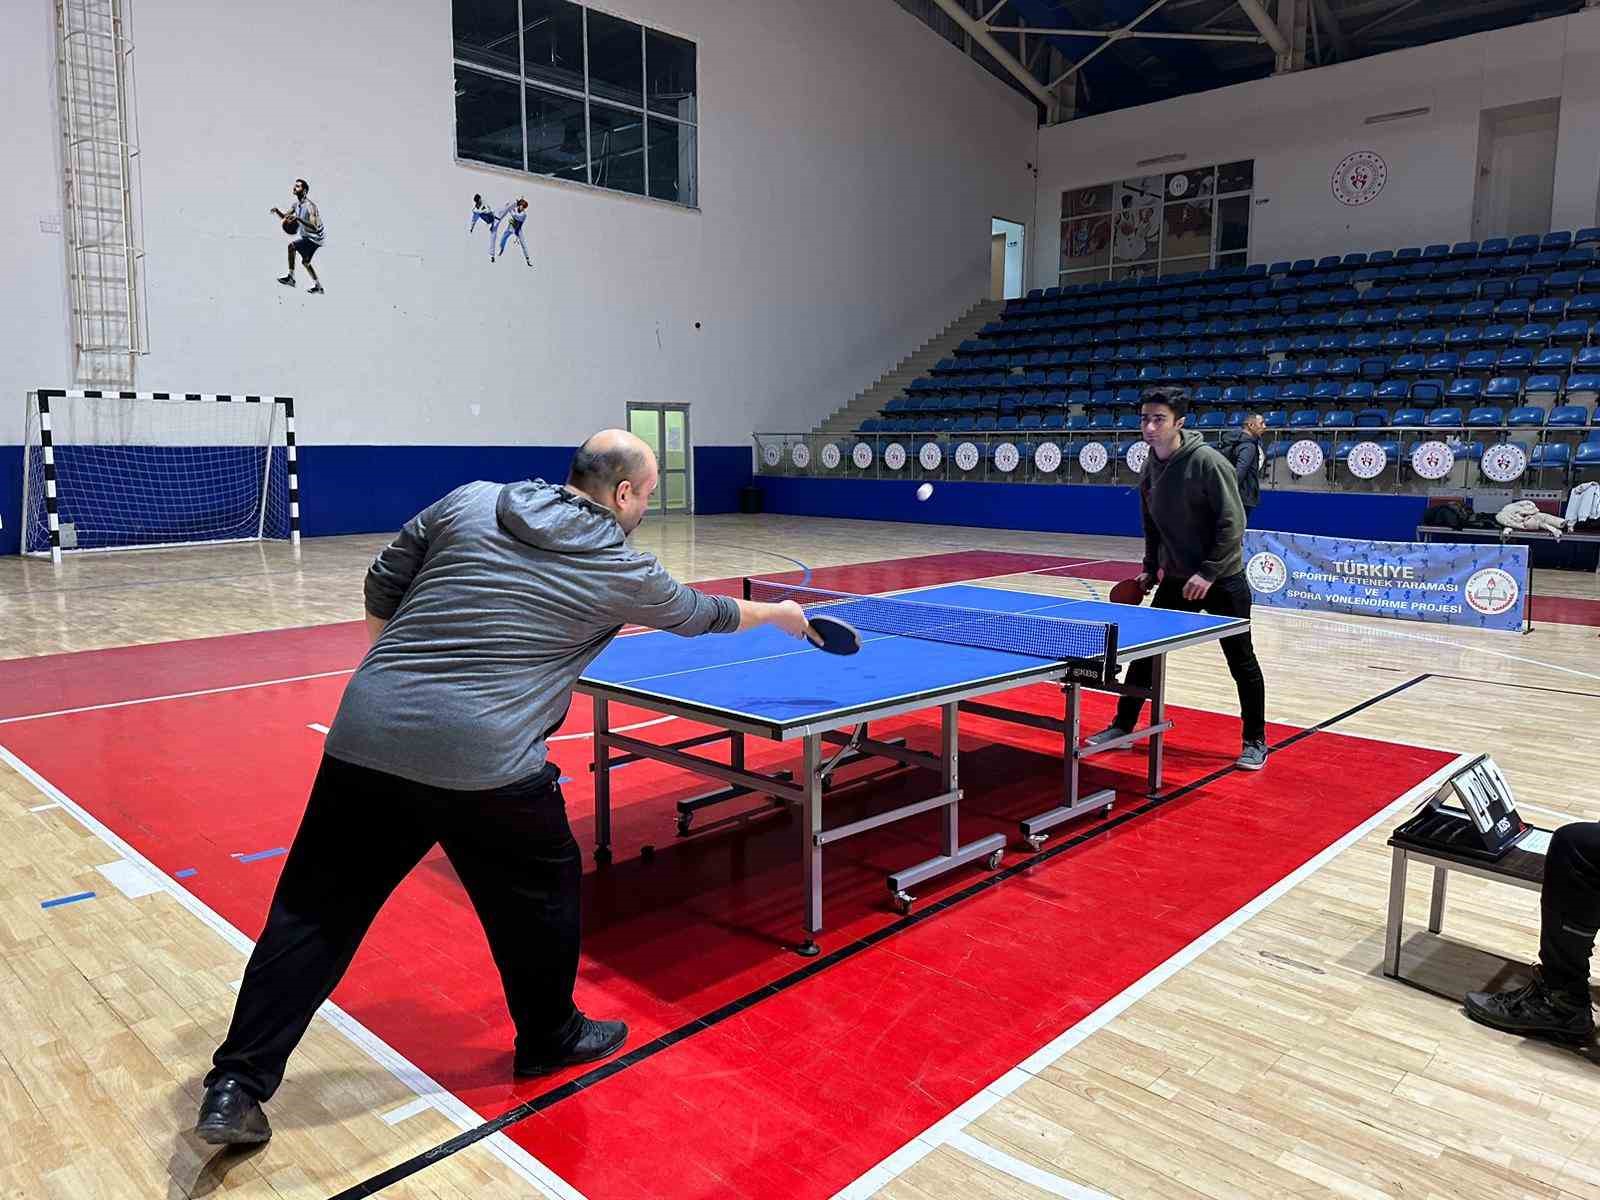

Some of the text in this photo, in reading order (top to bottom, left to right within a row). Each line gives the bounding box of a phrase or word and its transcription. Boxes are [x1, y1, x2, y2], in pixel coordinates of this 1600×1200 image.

[1333, 560, 1414, 579] TÜRKİYE
[1292, 571, 1459, 592] SPORTİF YETENEK TARAMASI
[1287, 590, 1322, 601] SPORA
[1364, 588, 1380, 597] VE
